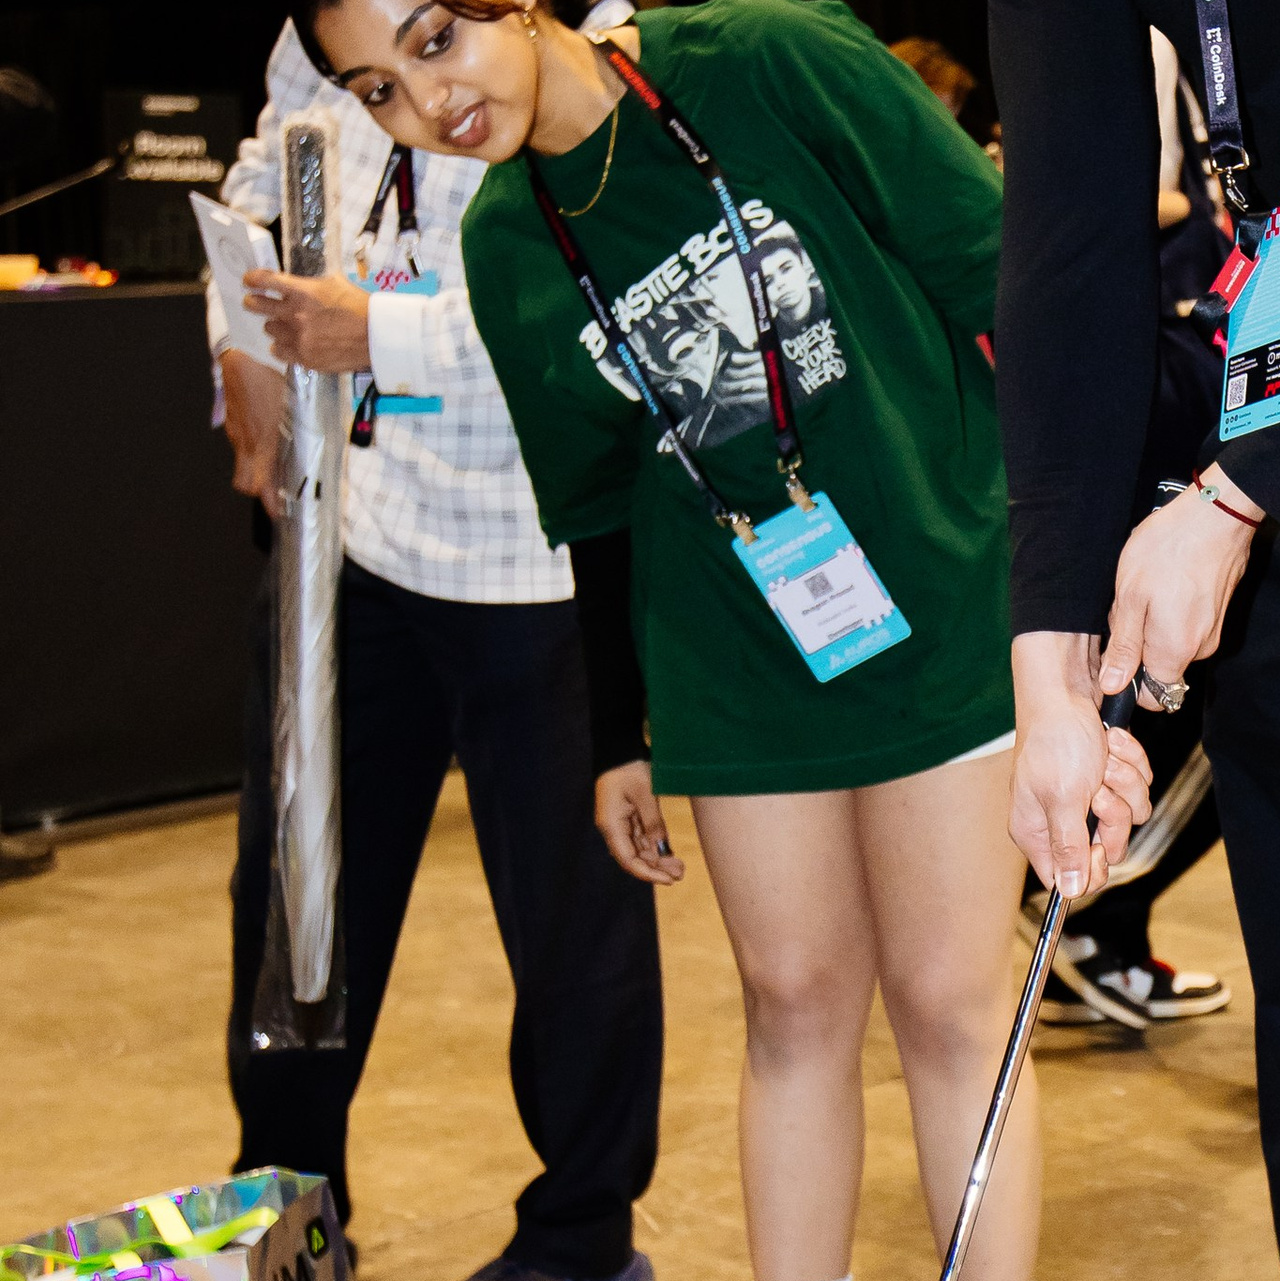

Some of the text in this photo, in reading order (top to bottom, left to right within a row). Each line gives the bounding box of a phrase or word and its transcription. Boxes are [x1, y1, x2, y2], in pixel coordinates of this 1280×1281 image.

[1210, 45, 1226, 106] CoinDesk
[578, 253, 690, 360] BASTIE
[680, 199, 774, 275] BOS
[781, 318, 837, 361] CHECK
[795, 336, 842, 372] YOUR
[797, 356, 847, 396] HEAD
